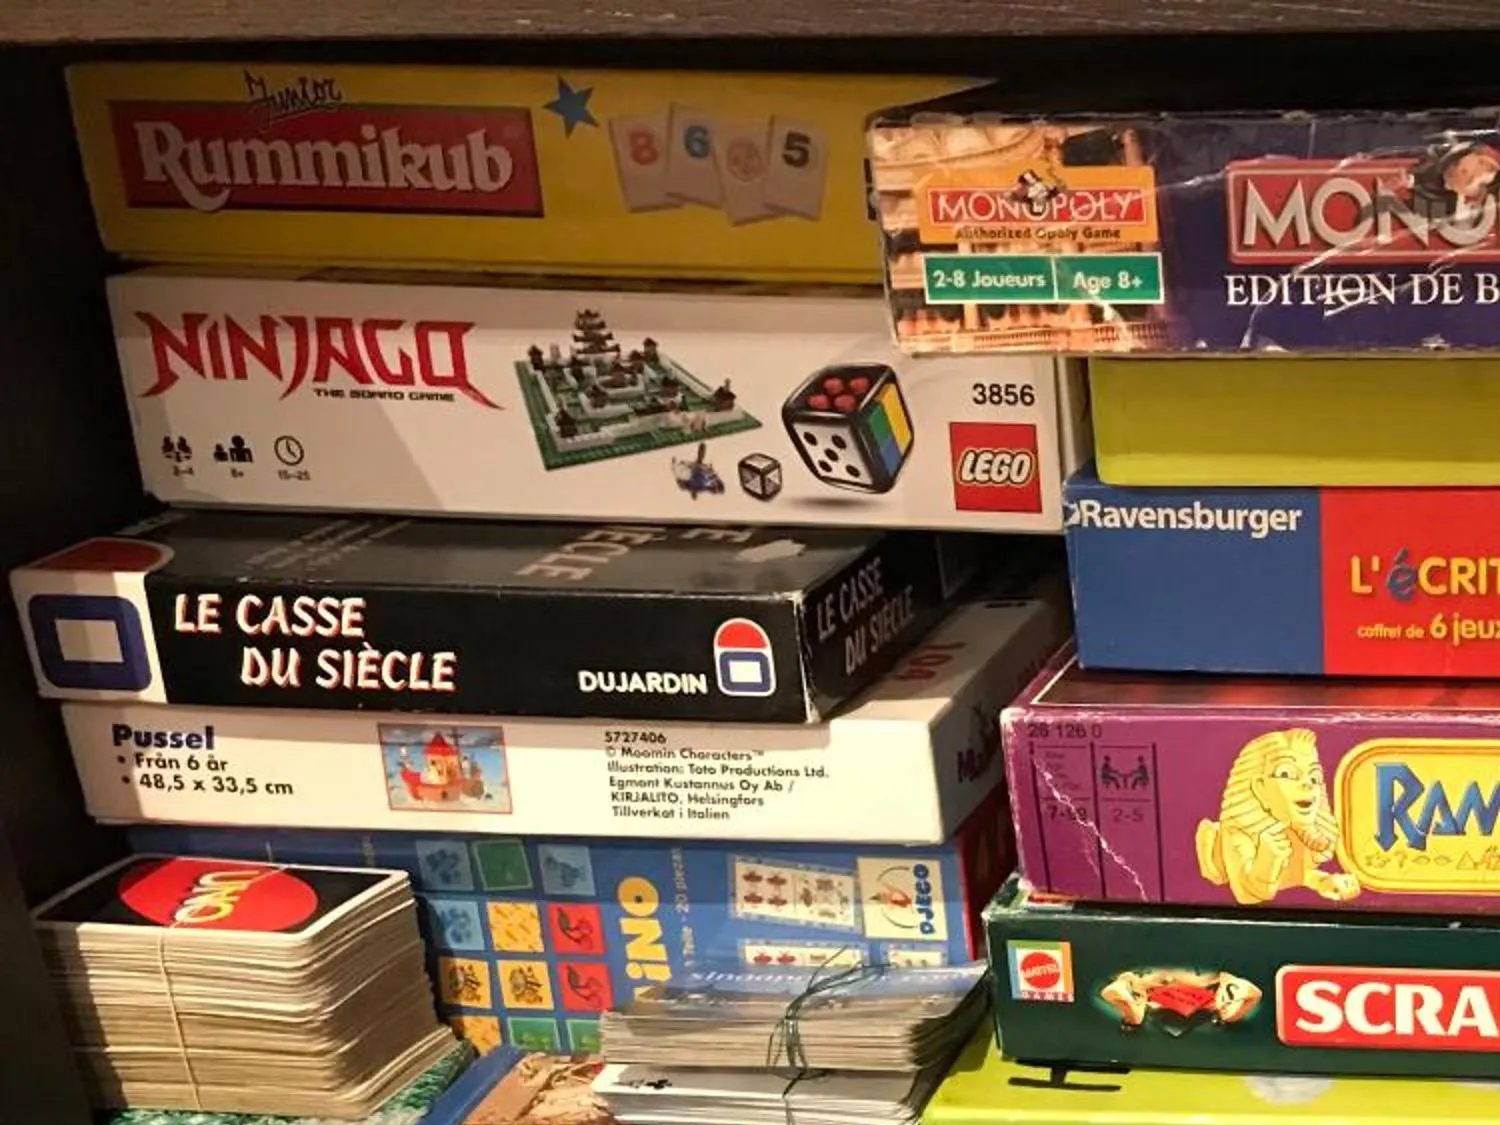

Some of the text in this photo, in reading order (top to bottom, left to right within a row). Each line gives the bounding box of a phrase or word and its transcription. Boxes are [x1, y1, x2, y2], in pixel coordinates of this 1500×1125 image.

[244, 69, 345, 118] Junior
[783, 134, 811, 168] 5
[133, 121, 514, 211] Rummikub
[938, 191, 1138, 221] MONOPOLY
[1083, 227, 1121, 240] Game
[933, 270, 1143, 292] 2-8 Joueurs Age 8+
[1226, 274, 1397, 308] EDITION
[1410, 275, 1461, 305] DE
[133, 311, 505, 411] NINJAGO
[314, 388, 455, 402] THE BOARD GAME
[972, 383, 1035, 407] 3856
[958, 449, 1034, 486] LEGO
[1081, 499, 1302, 538] Ravensburger
[175, 593, 367, 639] LE CASSE
[1406, 624, 1424, 639] de
[1429, 612, 1447, 640] 6
[240, 642, 457, 692] DU SIÈCLE
[578, 671, 707, 695] DUJARDIN
[112, 724, 215, 750] Pussel
[604, 731, 666, 744] 5727406
[134, 752, 229, 771] Från 6 år
[621, 747, 676, 760] Moomin
[607, 762, 829, 779] Illustration: Toto Productions Ltd.
[139, 773, 293, 796] 48,5 33,5 cm
[609, 777, 784, 793] Egmont Kustannus Oy Ab
[613, 805, 730, 820] Tillverkat Italien
[687, 794, 765, 807] Helsingfors
[173, 871, 260, 924] UNO
[913, 863, 935, 934] DJECO
